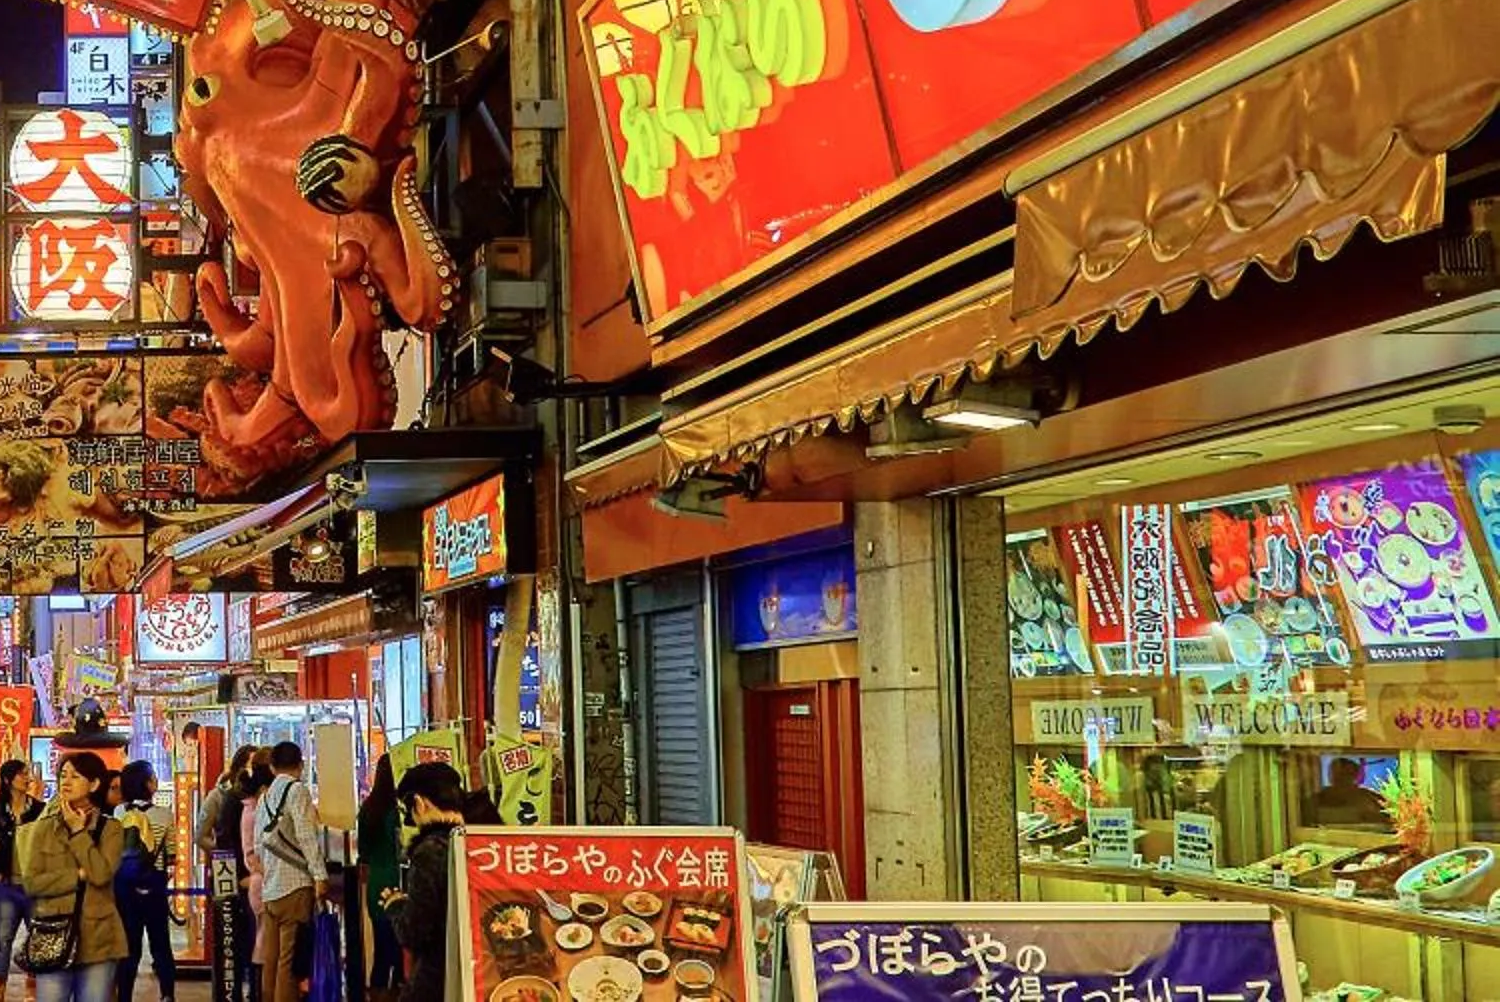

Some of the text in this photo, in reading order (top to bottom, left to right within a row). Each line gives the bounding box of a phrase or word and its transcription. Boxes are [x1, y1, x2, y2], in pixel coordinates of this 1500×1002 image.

[69, 42, 85, 55] 4F
[13, 108, 133, 312] 大阪
[67, 439, 201, 466] 海鮮居酒屋
[1195, 700, 1339, 737] WELCOME
[217, 861, 233, 895] 入口
[467, 840, 730, 888] づぼらやのふぐ会席
[815, 928, 1048, 977] づぼらやの
[974, 975, 1274, 1002] お得てっちりコース
